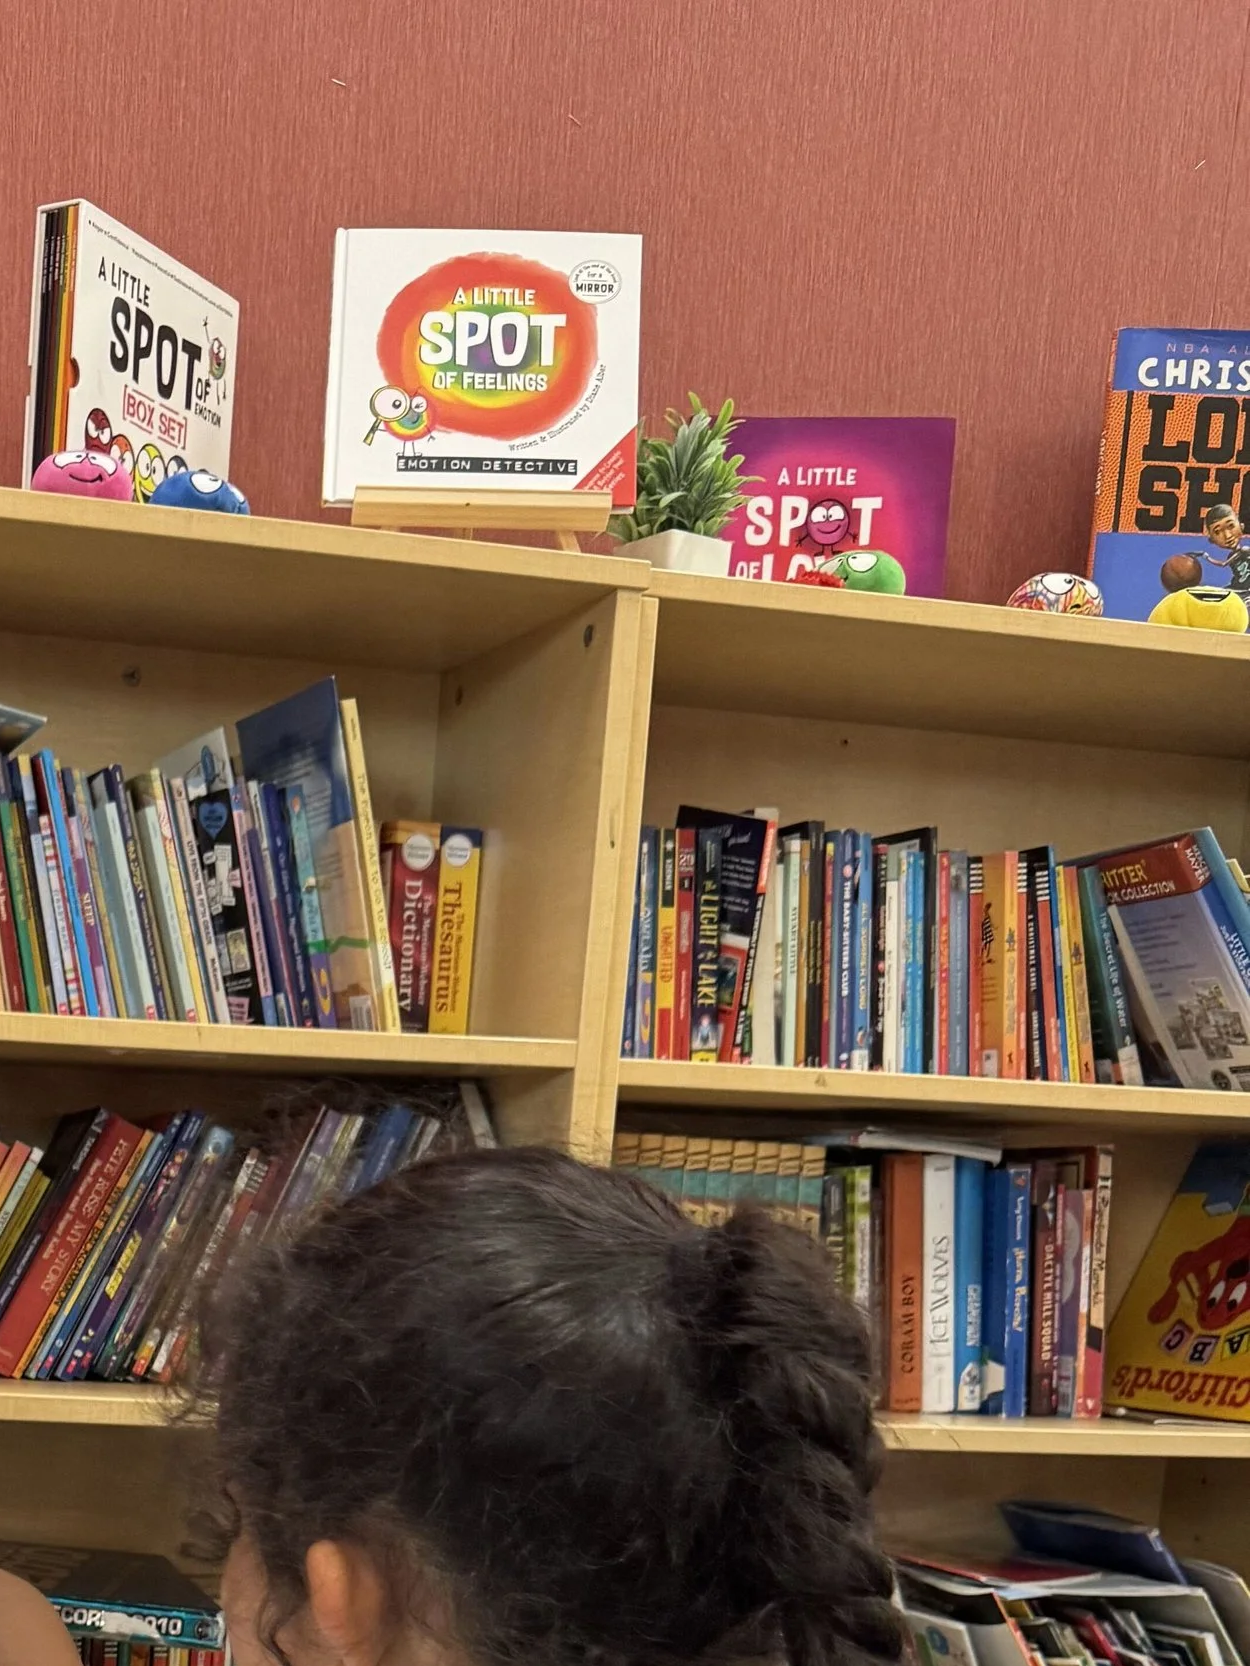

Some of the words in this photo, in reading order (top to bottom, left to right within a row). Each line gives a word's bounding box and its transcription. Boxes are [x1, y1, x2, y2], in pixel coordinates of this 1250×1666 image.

[98, 257, 106, 281] A
[111, 262, 150, 307] LITTLE
[576, 283, 614, 293] MIRROR
[454, 288, 465, 304] A
[473, 288, 536, 305] LITTLE
[419, 311, 567, 366] SPOT
[1166, 343, 1211, 353] NBA
[110, 296, 202, 410] SPOT
[195, 378, 210, 403] OF
[433, 372, 457, 390] OF
[463, 372, 547, 391] FEELINGS
[195, 403, 221, 428] EMOTION
[579, 403, 589, 413] by
[398, 459, 471, 470] EMOTION
[482, 460, 577, 473] DETECTIVE
[778, 468, 790, 485] A
[797, 467, 857, 485] LITTLE
[1135, 465, 1250, 534] SH
[736, 562, 760, 579] OF
[355, 774, 367, 793] The
[358, 800, 373, 839] Pigeon
[186, 840, 195, 855] LIVE
[366, 844, 378, 869] HAS
[679, 855, 695, 866] 20
[189, 858, 200, 880] FROM
[369, 870, 380, 885] to
[663, 858, 672, 890] KORMAN
[1183, 846, 1205, 884] MAYER
[194, 882, 203, 896] THE
[843, 881, 852, 898] THE
[1122, 880, 1176, 901] COLLECTION
[197, 898, 207, 918] FIFTH
[375, 908, 385, 922] to
[422, 894, 431, 914] The
[861, 901, 869, 923] ALL
[201, 919, 213, 945] GRADE
[454, 914, 464, 930] The
[698, 894, 720, 948] LIGHT
[1098, 911, 1110, 929] The
[397, 879, 423, 1010] Dictionary
[434, 881, 463, 1013] Thesaurus
[841, 901, 851, 969] BABY-SITTERS
[1026, 922, 1035, 964] CHRISTMAS
[859, 927, 868, 975] SUMMER
[1102, 935, 1117, 965] Secret
[1227, 931, 1250, 966] LITTLE
[208, 957, 221, 992] McKenna
[416, 919, 430, 1005] Merriam-Webster
[449, 934, 463, 1012] Merriam-Webster
[696, 963, 717, 1007] LAKE
[840, 971, 849, 996] CLUB
[1108, 967, 1119, 984] Life
[858, 980, 867, 1009] LONG
[1111, 986, 1121, 997] of
[1031, 1010, 1039, 1038] CHARLES
[1113, 997, 1129, 1028] Water
[1032, 1040, 1040, 1066] DICKENS
[70, 1135, 95, 1172] TARSHIS
[102, 1137, 129, 1176] PETE
[68, 1194, 82, 1212] and
[106, 1184, 123, 1208] WIN
[54, 1210, 73, 1237] Roger
[96, 1210, 109, 1226] AT
[63, 1219, 87, 1250] MY
[37, 1247, 71, 1296] STORY
[52, 1224, 101, 1307] BACKGAMMON
[929, 1235, 950, 1313] WOLVES
[1043, 1244, 1053, 1289] DACTYL
[901, 1272, 914, 1305] BOY
[1042, 1292, 1052, 1317] HILL
[900, 1312, 914, 1372] CORAM
[929, 1314, 949, 1344] ICE
[1040, 1320, 1051, 1360] SQUAD
